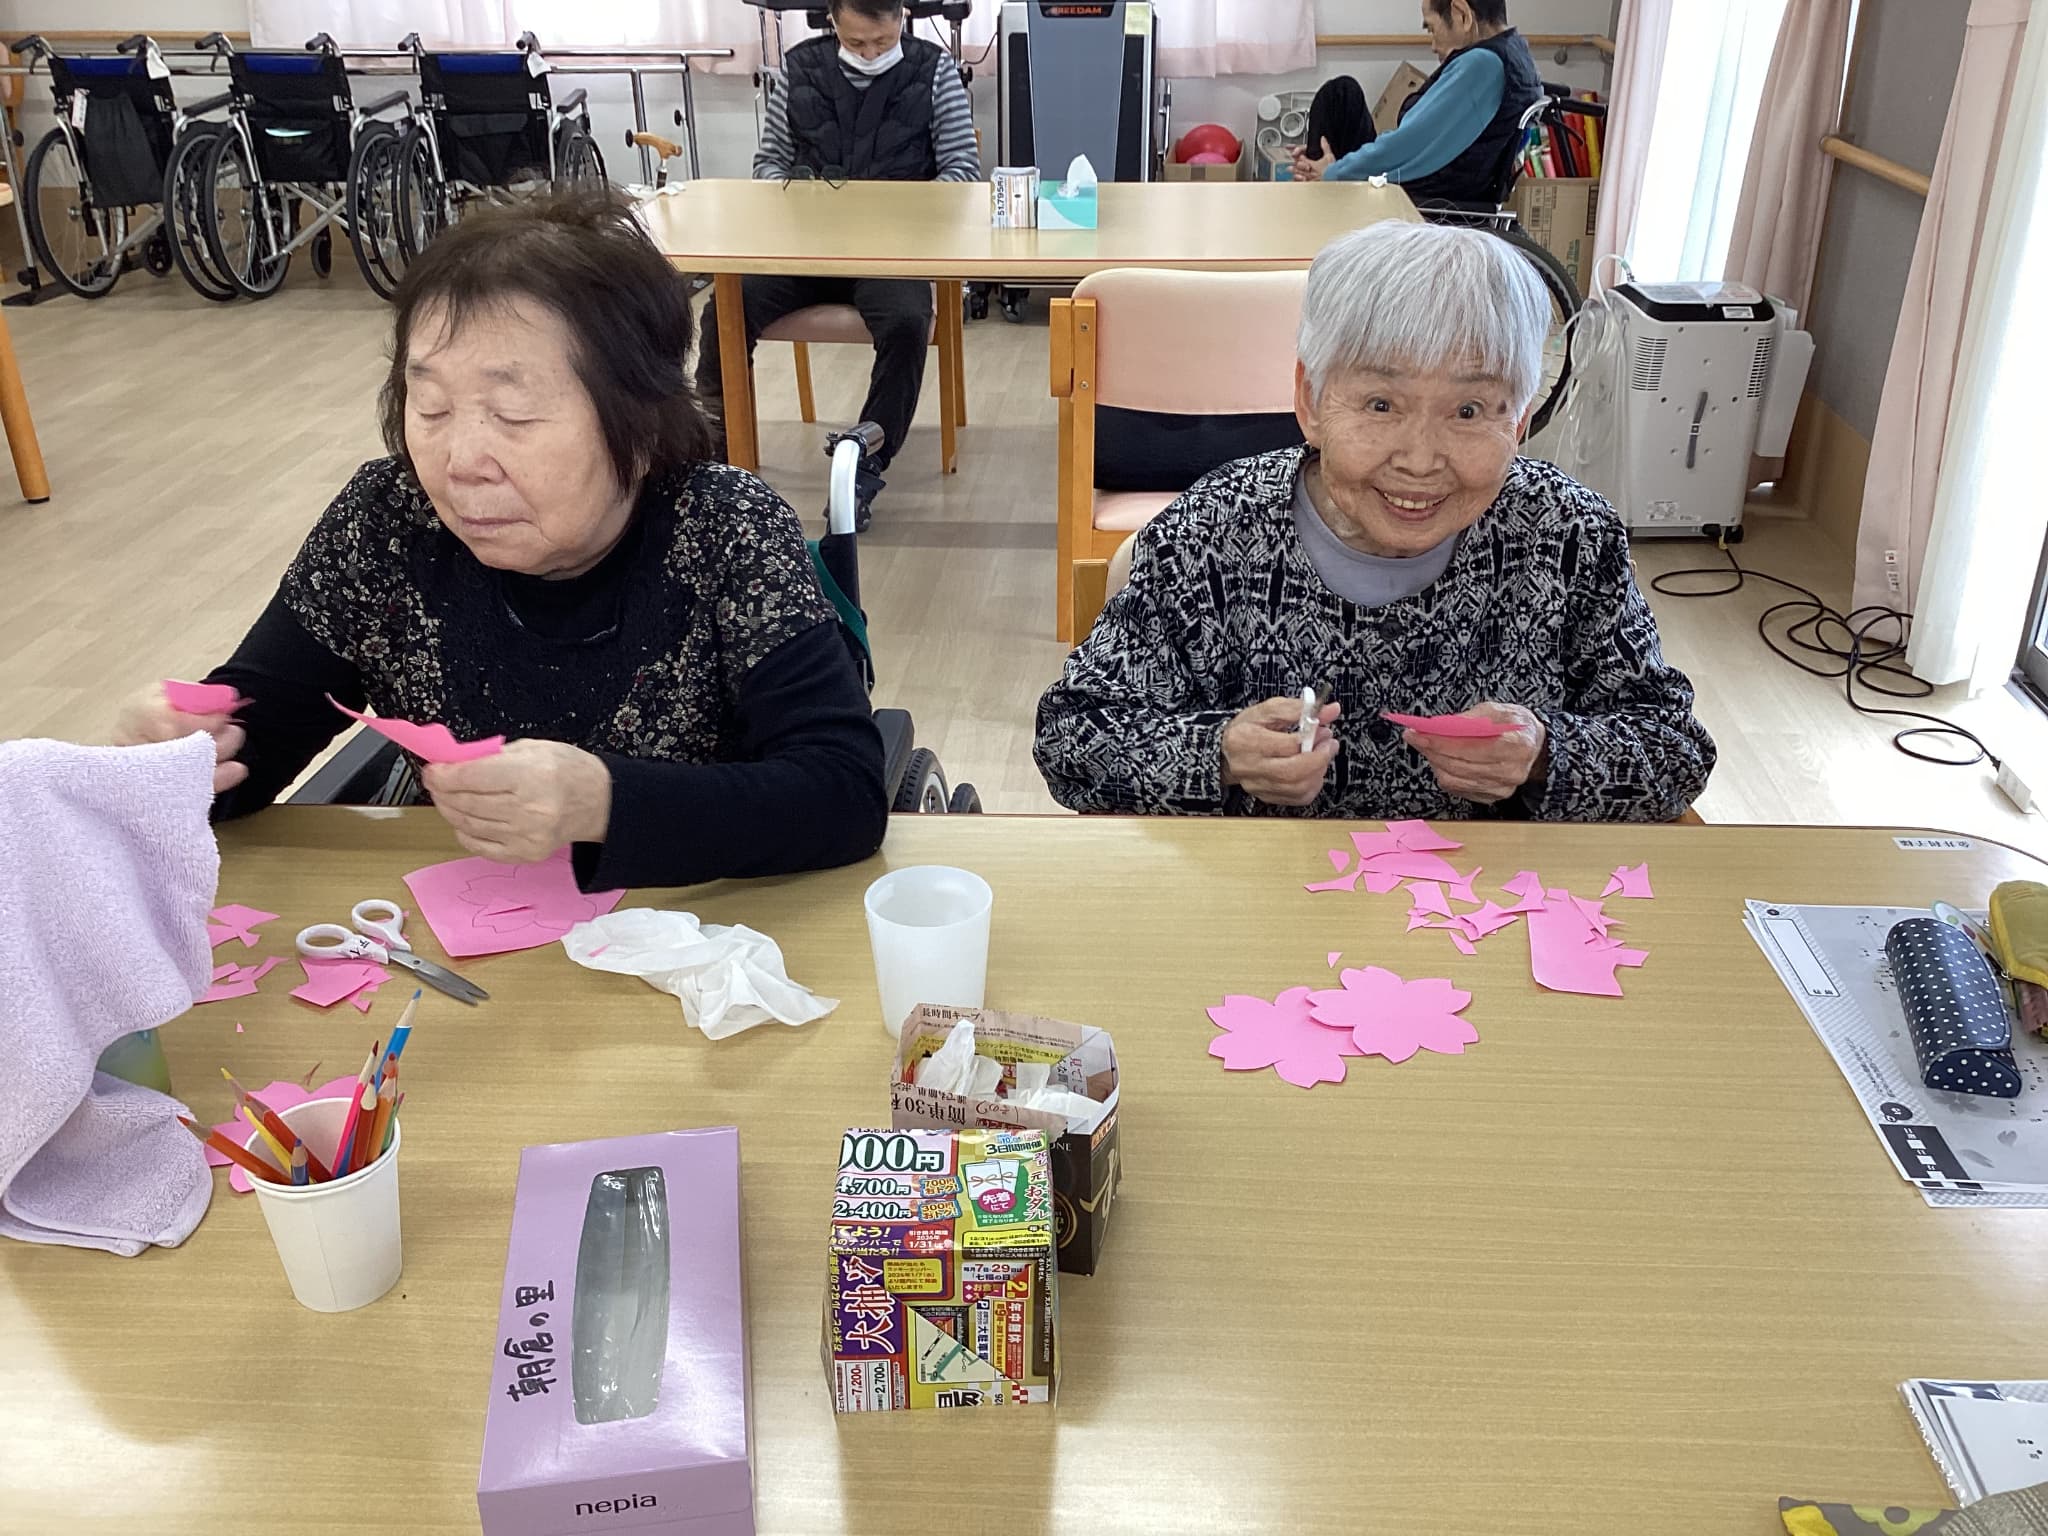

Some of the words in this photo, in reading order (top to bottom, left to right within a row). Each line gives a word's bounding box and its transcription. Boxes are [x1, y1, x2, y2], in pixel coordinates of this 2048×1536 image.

[982, 1191, 1011, 1204] 先着
[991, 1203, 1009, 1211] にて
[831, 1225, 891, 1238] てよう!
[831, 1236, 902, 1246] のナンバーで
[503, 1279, 557, 1402] 朝倉の里
[575, 1493, 658, 1516] nepia
